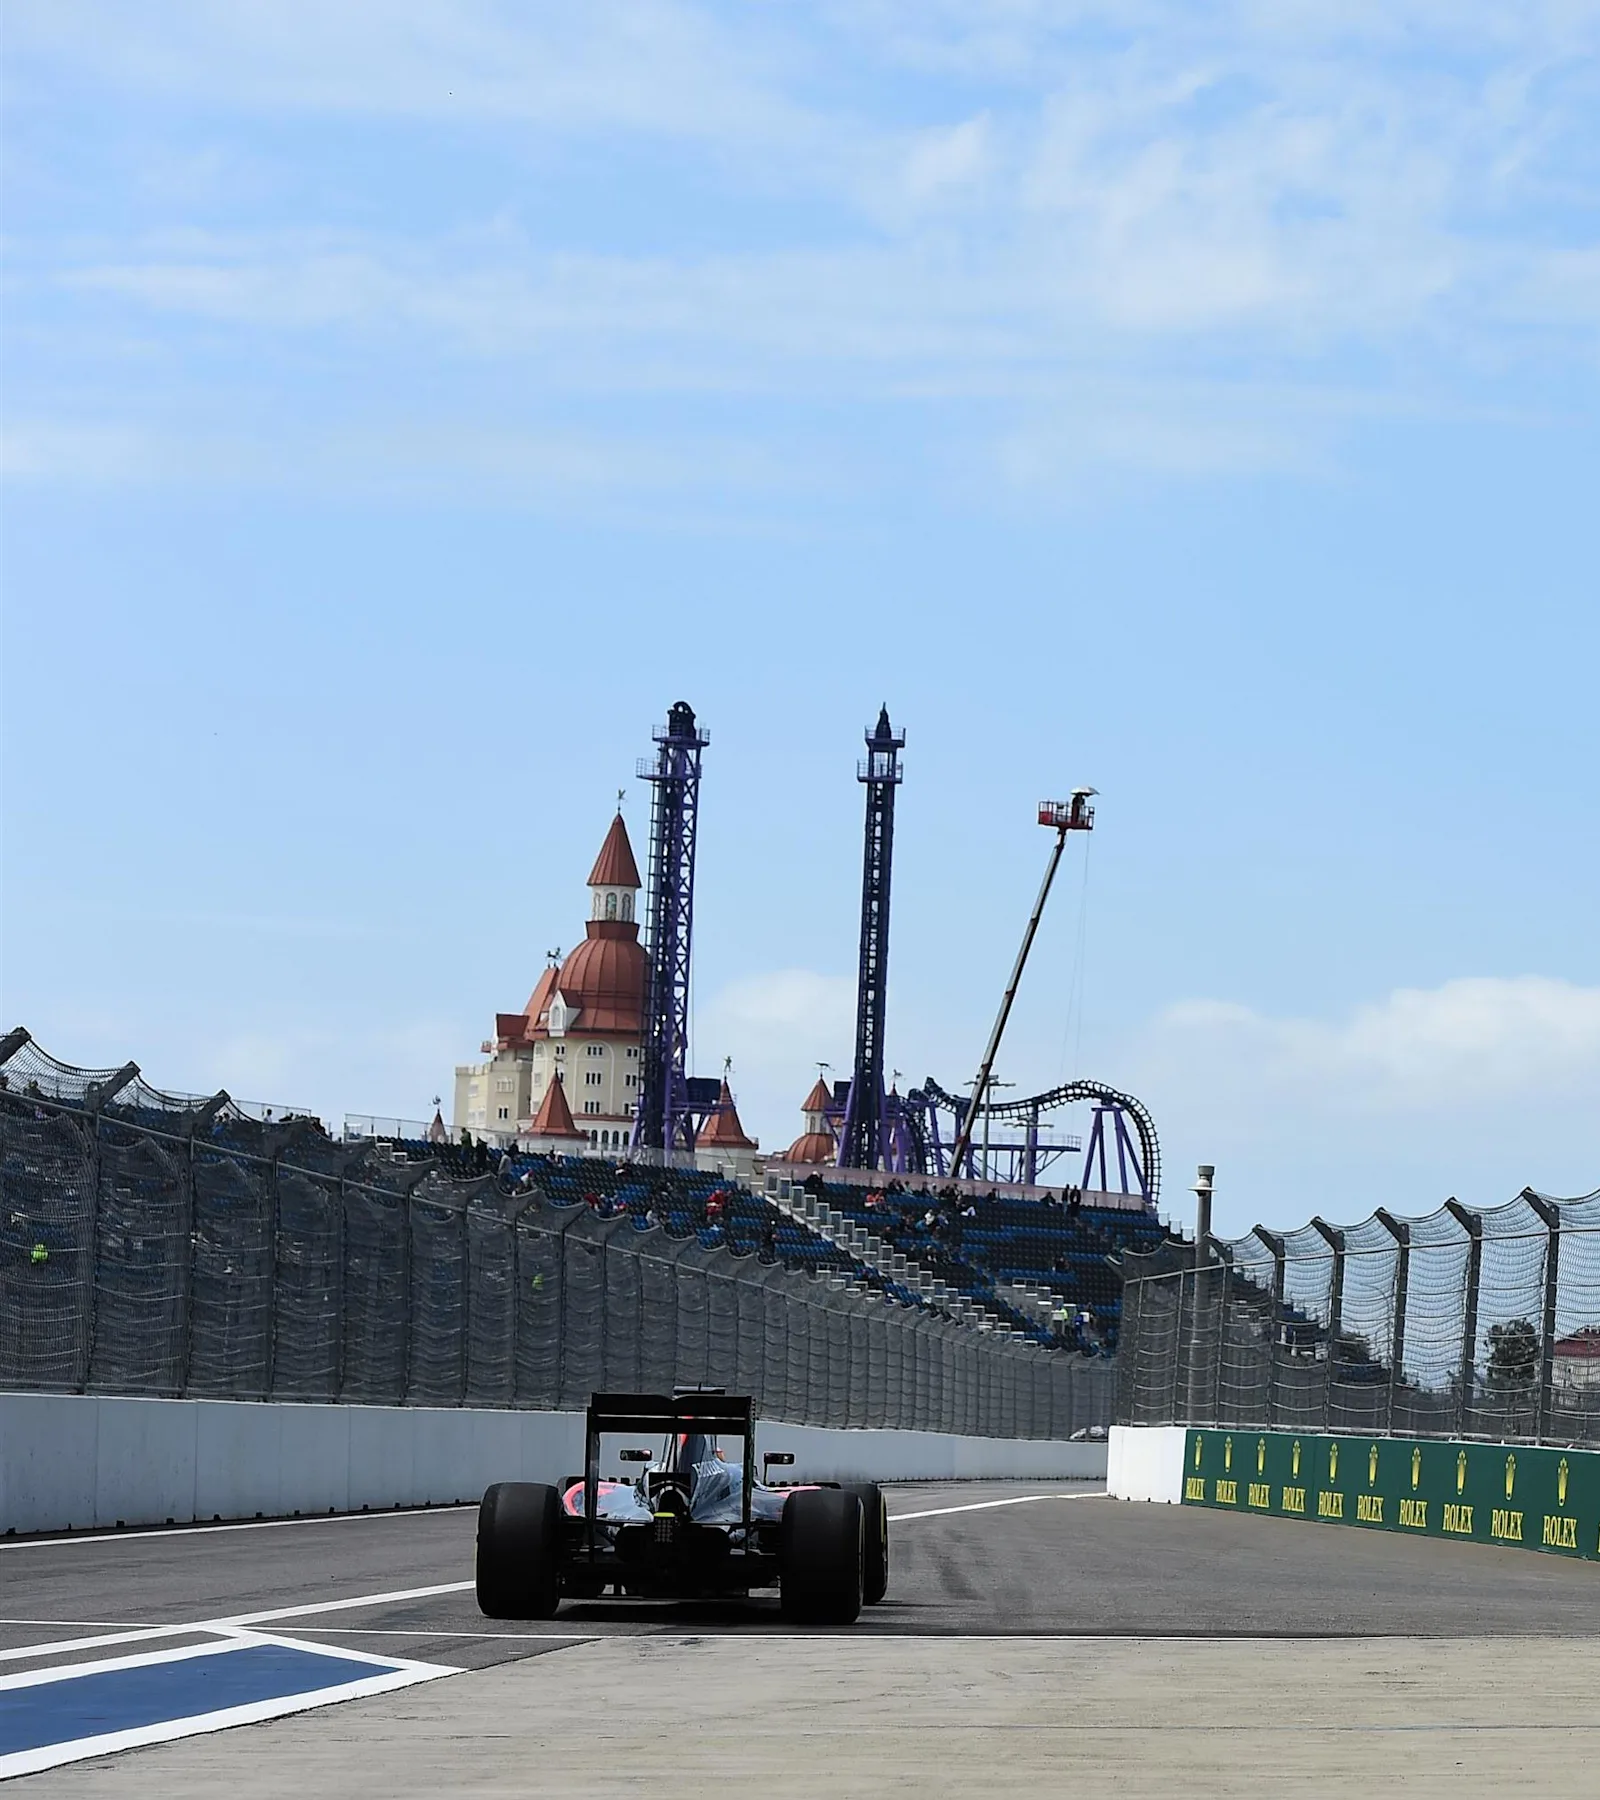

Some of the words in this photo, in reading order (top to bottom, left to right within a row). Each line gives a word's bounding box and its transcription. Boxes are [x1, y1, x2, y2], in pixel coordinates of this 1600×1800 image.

[1216, 1479, 1238, 1504] ROLEX
[1248, 1483, 1271, 1508] ROLEX
[1282, 1486, 1306, 1512] ROLEX
[1318, 1491, 1344, 1518] ROLEX
[1357, 1495, 1384, 1523] ROLEX
[1399, 1499, 1428, 1528] ROLEX
[1443, 1503, 1474, 1534] ROLEX
[1491, 1509, 1523, 1541] ROLEX
[1543, 1515, 1577, 1548] ROLEX
